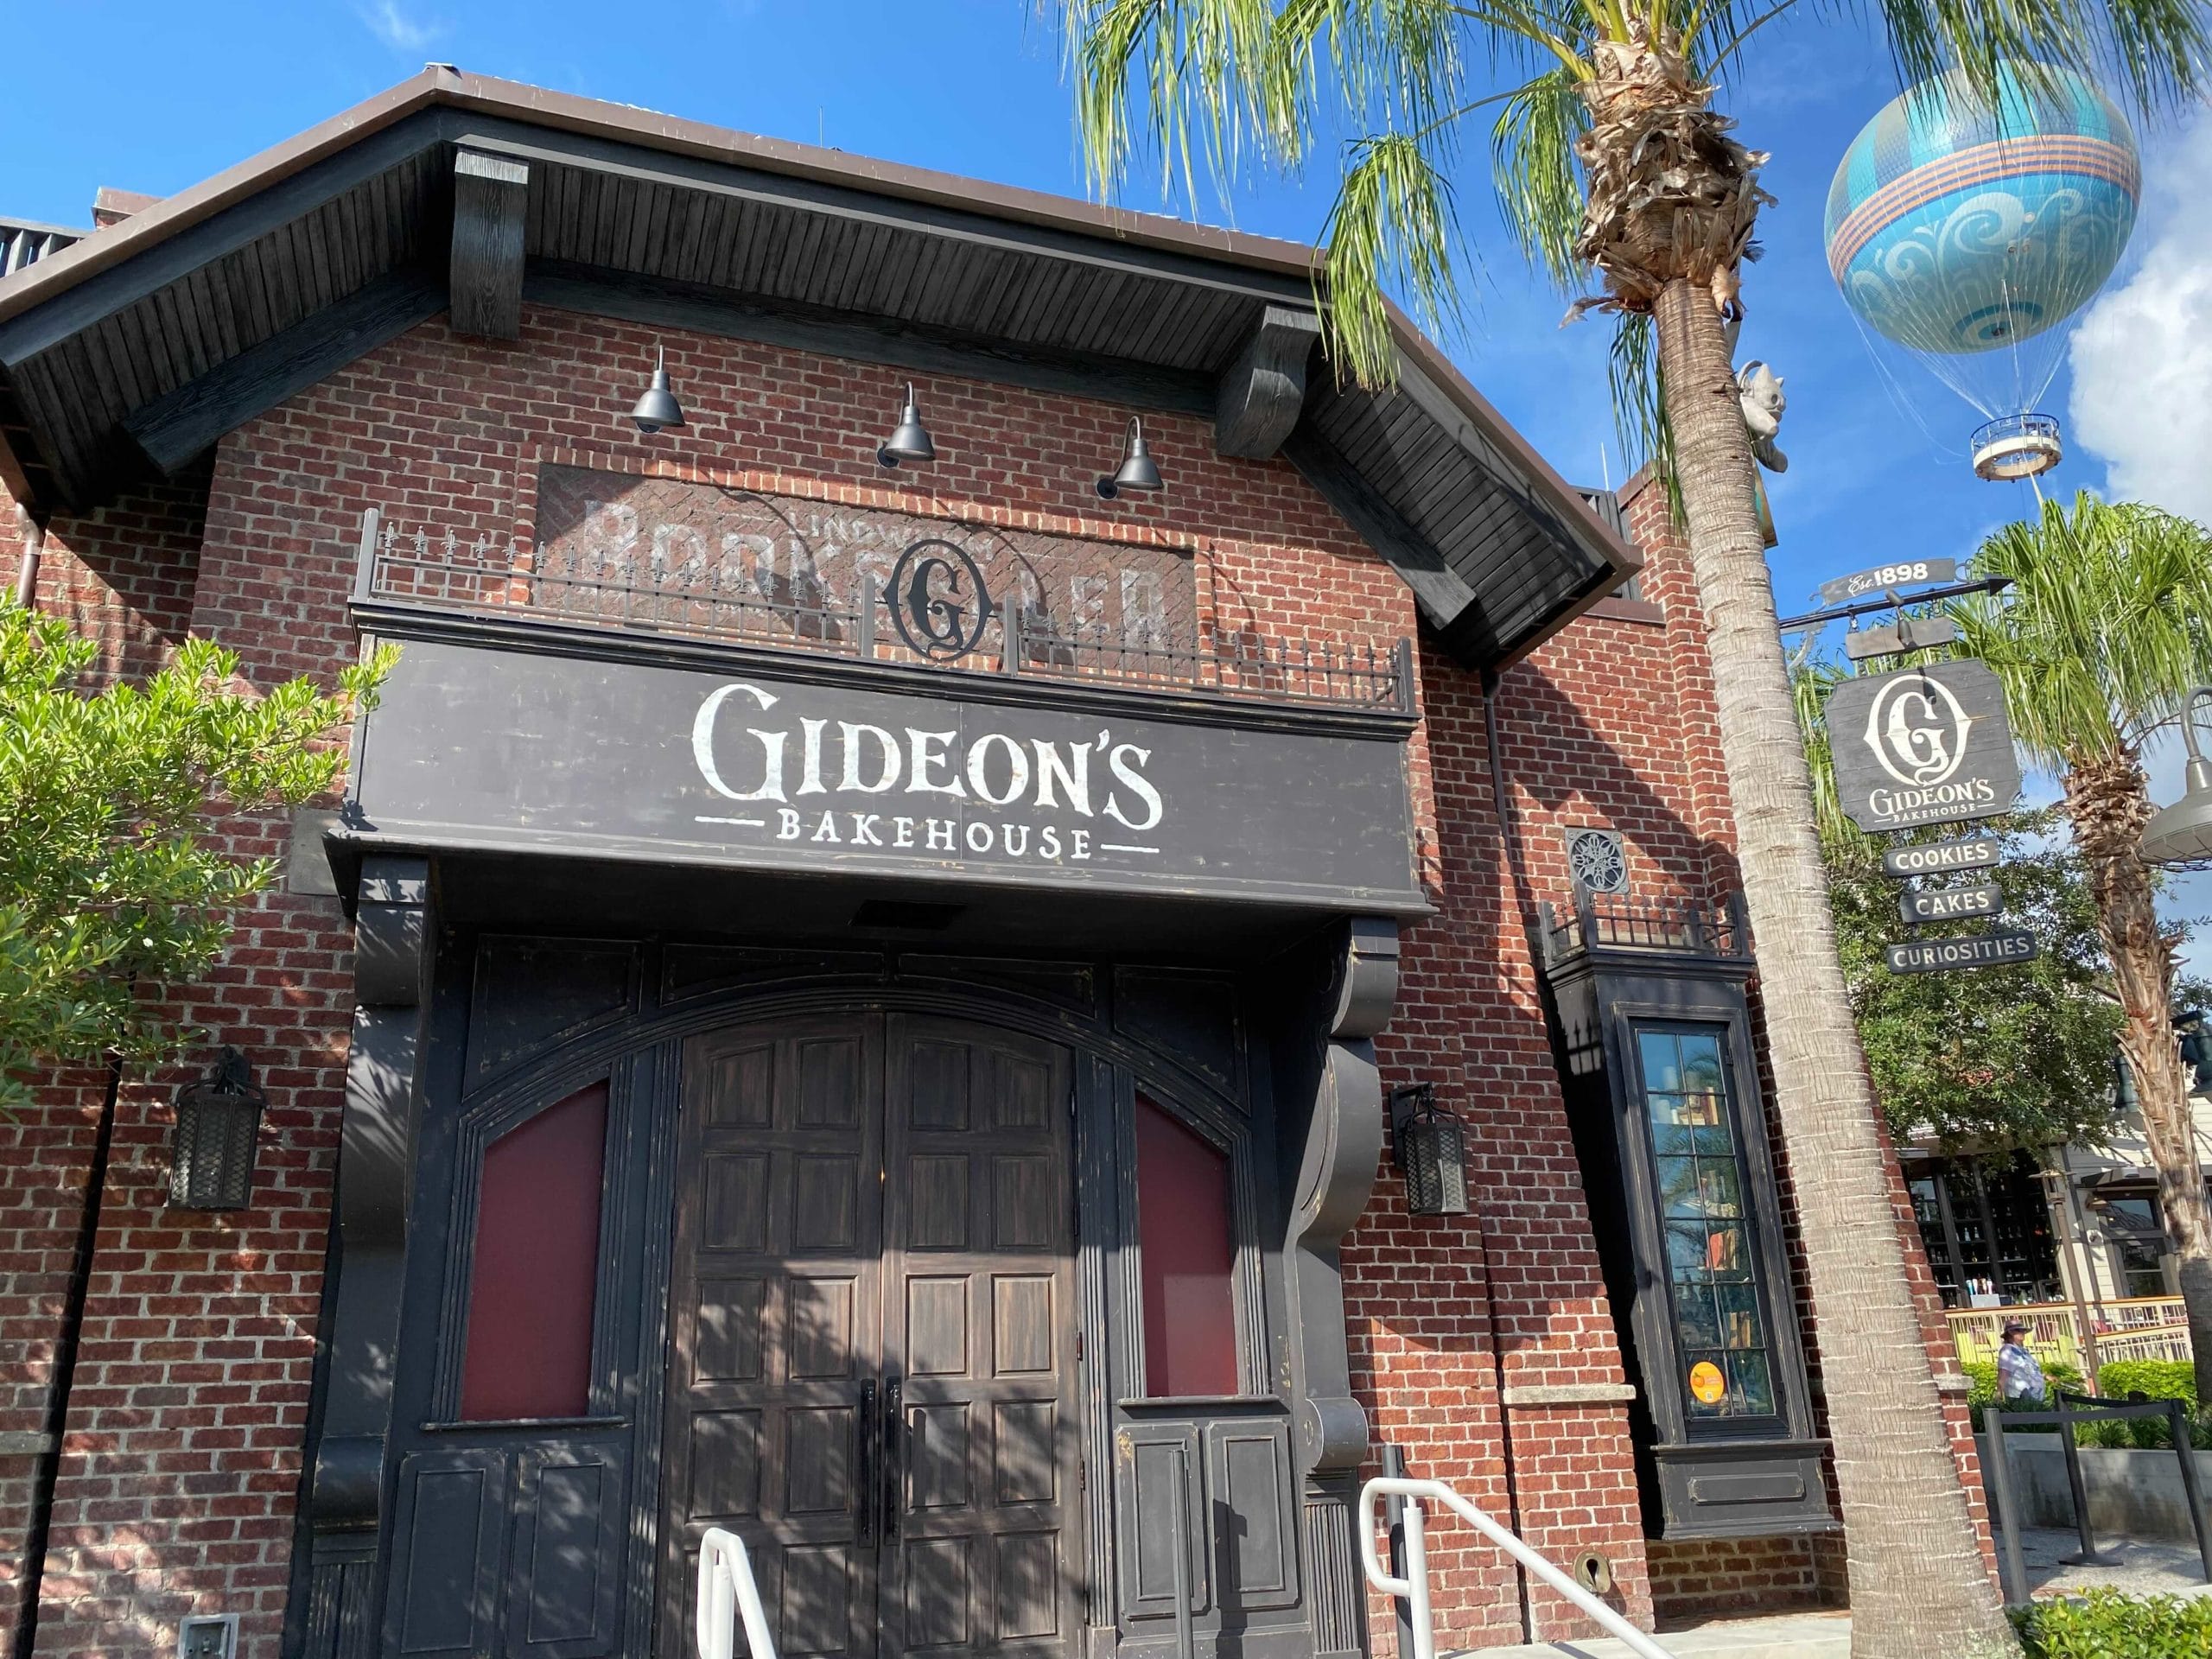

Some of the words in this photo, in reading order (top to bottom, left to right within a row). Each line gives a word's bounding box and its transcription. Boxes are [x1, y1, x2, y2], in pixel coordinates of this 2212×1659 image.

[1847, 575, 1874, 597] Est.
[1873, 563, 1929, 587] 1898
[691, 683, 1164, 831] GIDEON'S
[1869, 777, 1995, 816] GIDEON'S
[1893, 803, 1977, 823] BAKEHOUSE
[777, 808, 1091, 860] BAKEHOUSE
[1895, 842, 1989, 870] COOKIES
[1916, 891, 1990, 916] CAKES
[1893, 936, 2030, 968] CURIOSITIES
